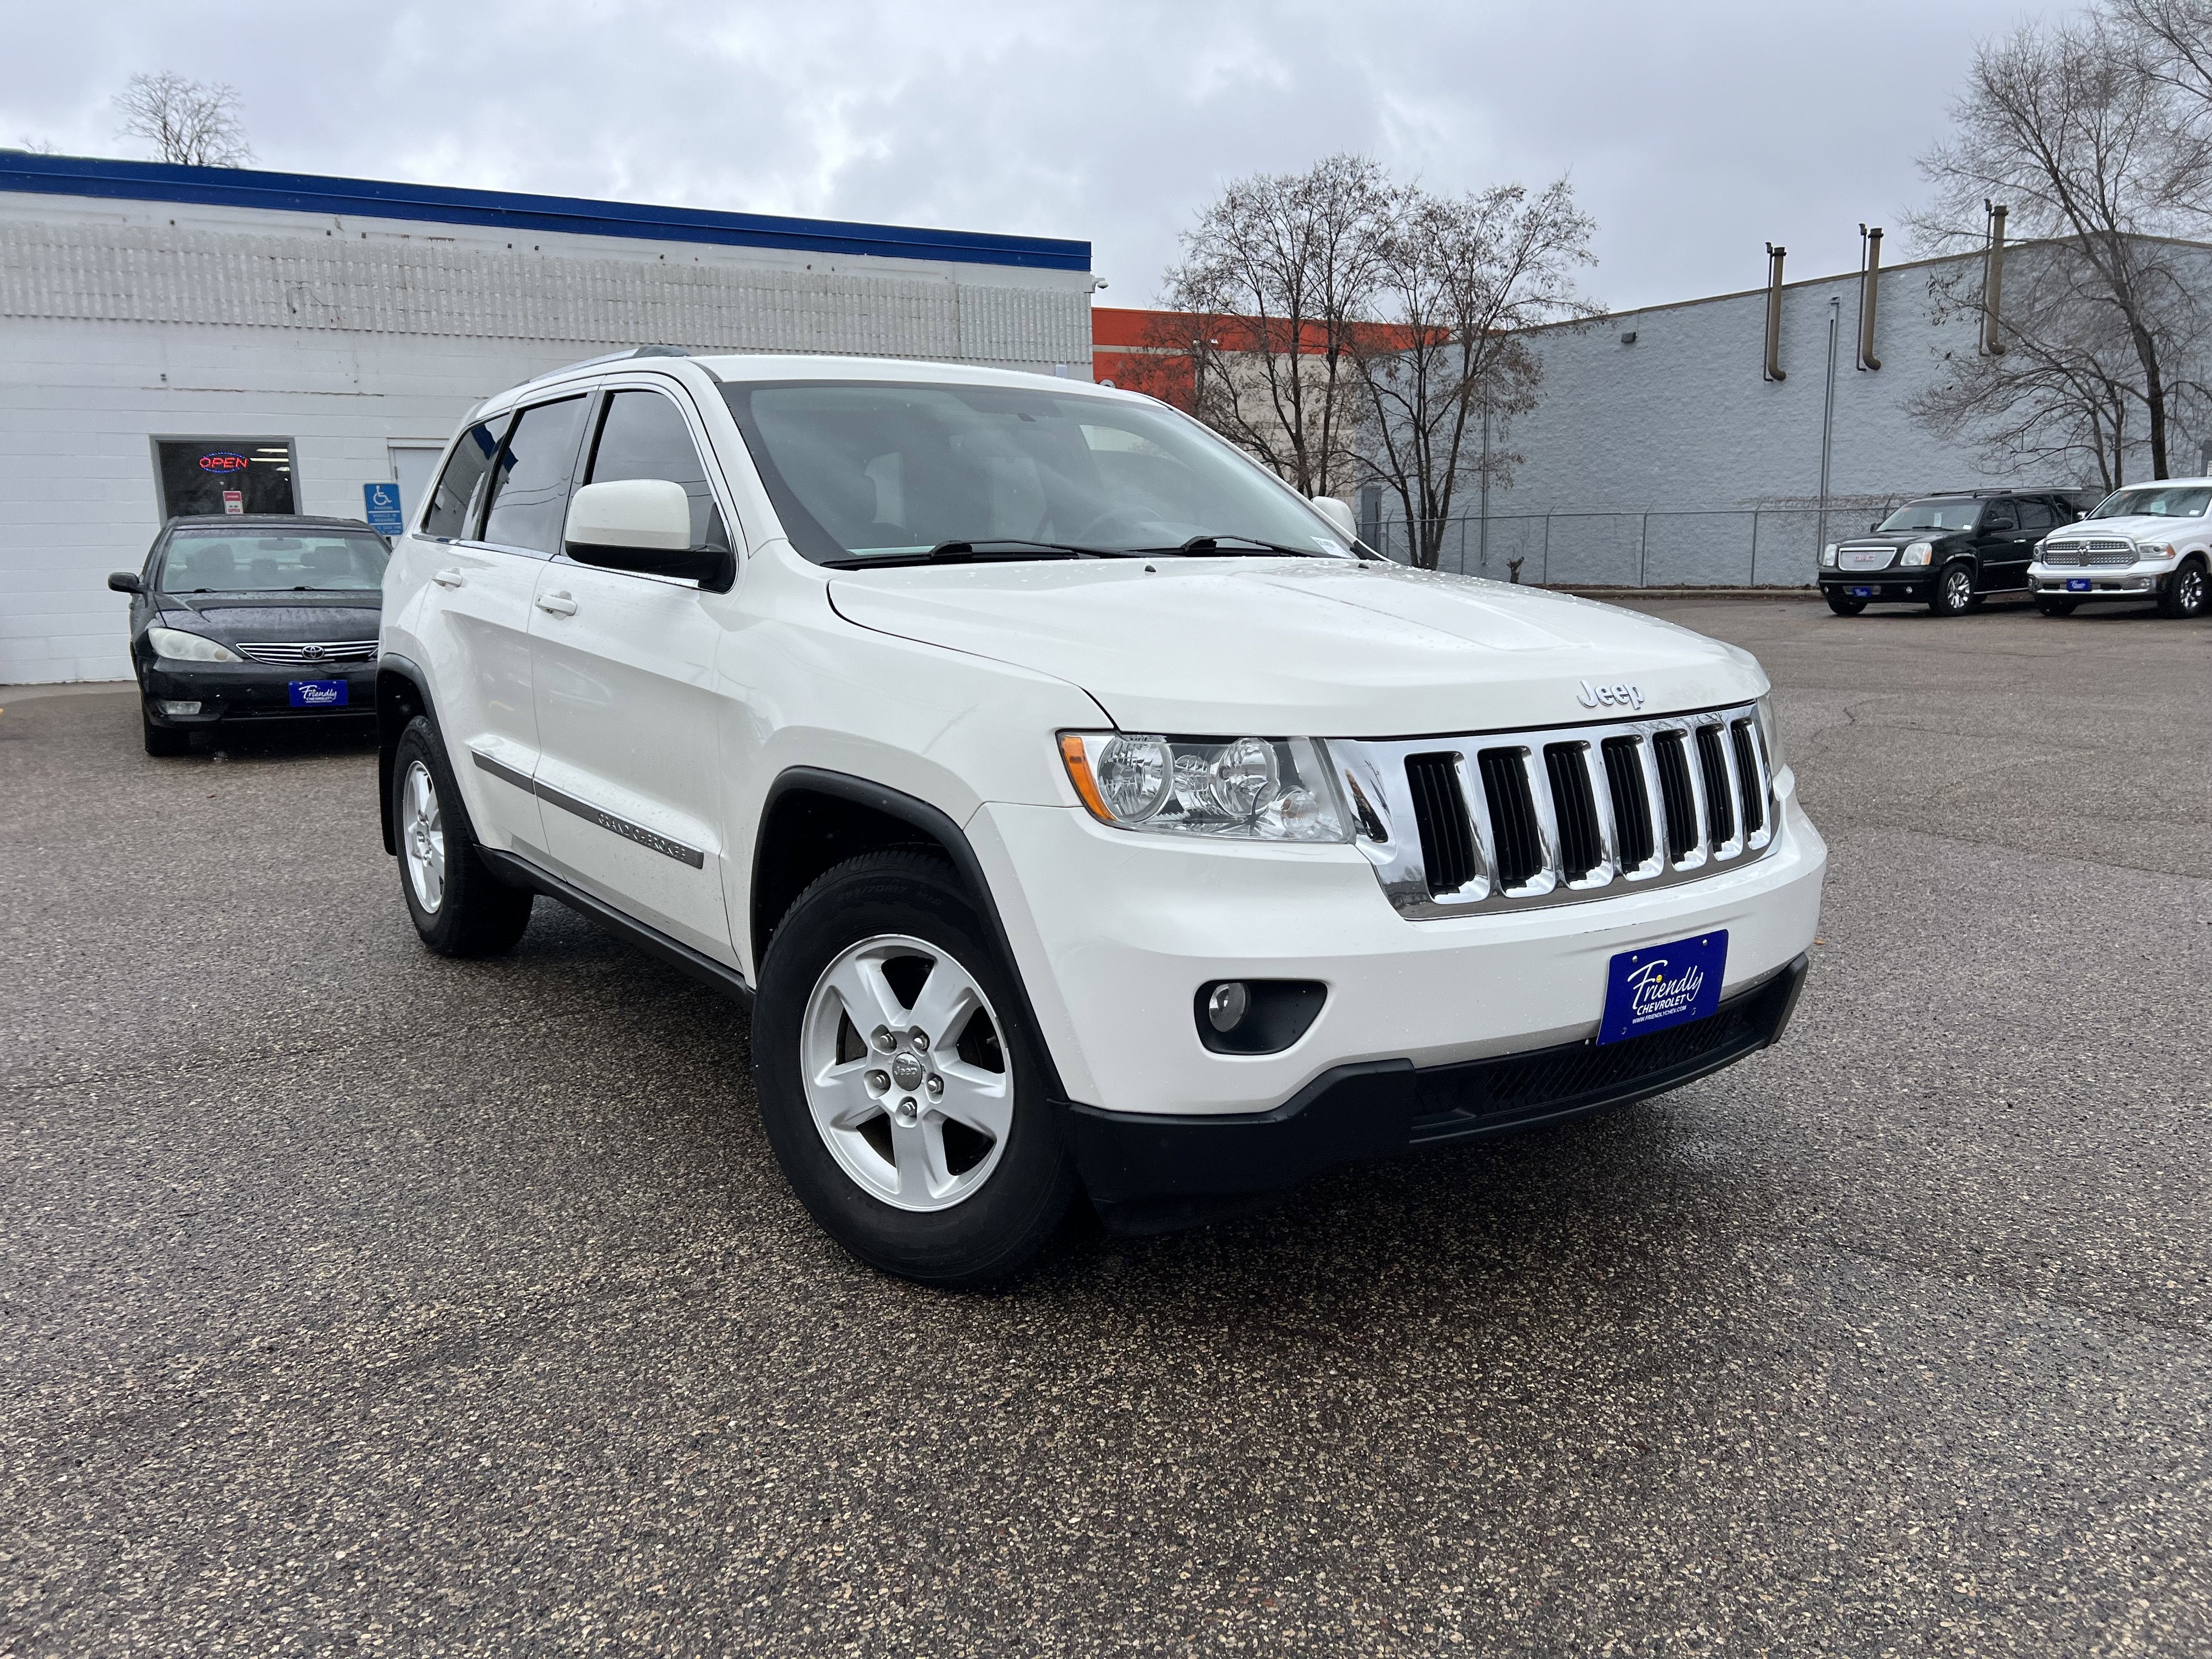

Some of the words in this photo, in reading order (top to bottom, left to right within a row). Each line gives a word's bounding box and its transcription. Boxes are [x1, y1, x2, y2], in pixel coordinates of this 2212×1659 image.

[199, 456, 249, 469] OPEN
[298, 685, 337, 700] Friendly
[1577, 680, 1645, 710] Jeep
[597, 812, 630, 837] GRAND
[632, 828, 686, 860] CHEROKEE
[1627, 959, 1704, 1010] Friendly
[1632, 1005, 1688, 1024] WWW.FRIENDLYCHEV.COM
[1637, 994, 1687, 1016] CHEVROLET
[894, 1065, 917, 1077] Jeep
